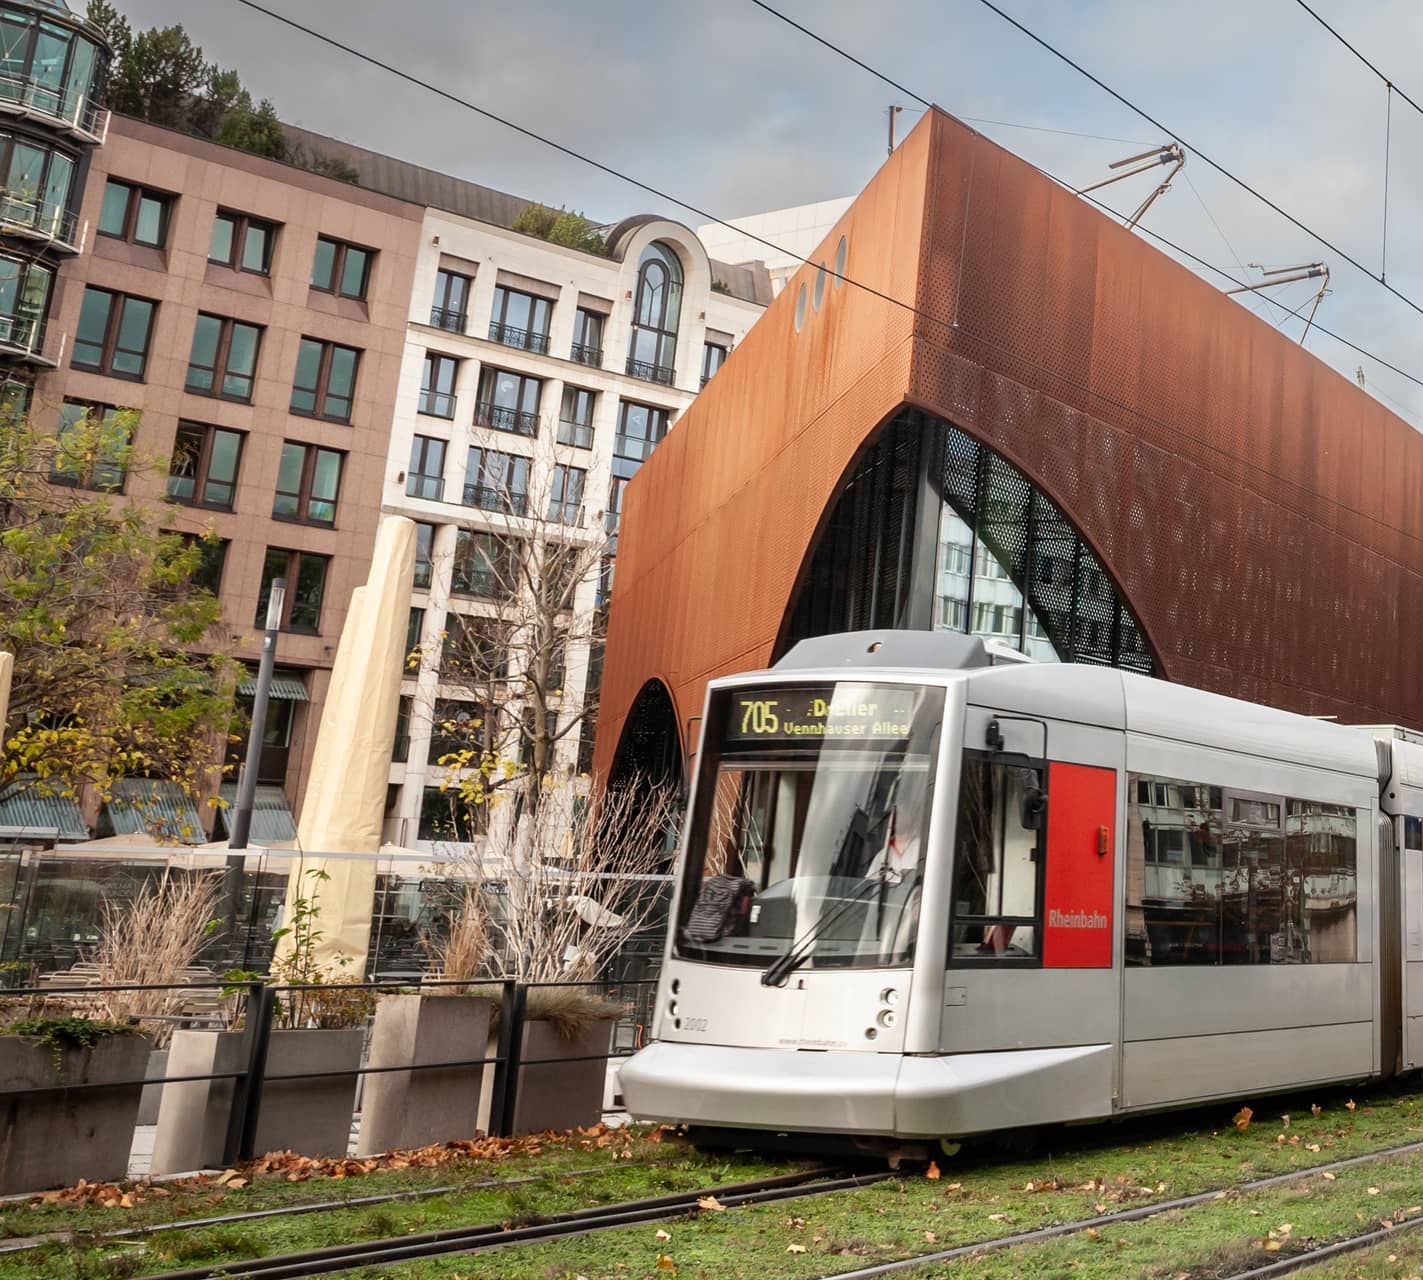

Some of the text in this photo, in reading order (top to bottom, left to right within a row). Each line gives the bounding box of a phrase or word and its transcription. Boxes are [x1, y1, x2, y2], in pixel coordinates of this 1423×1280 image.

[739, 701, 779, 734] 705
[783, 721, 909, 736] Vennhauser Allee
[1048, 909, 1108, 929] Rheinbahn
